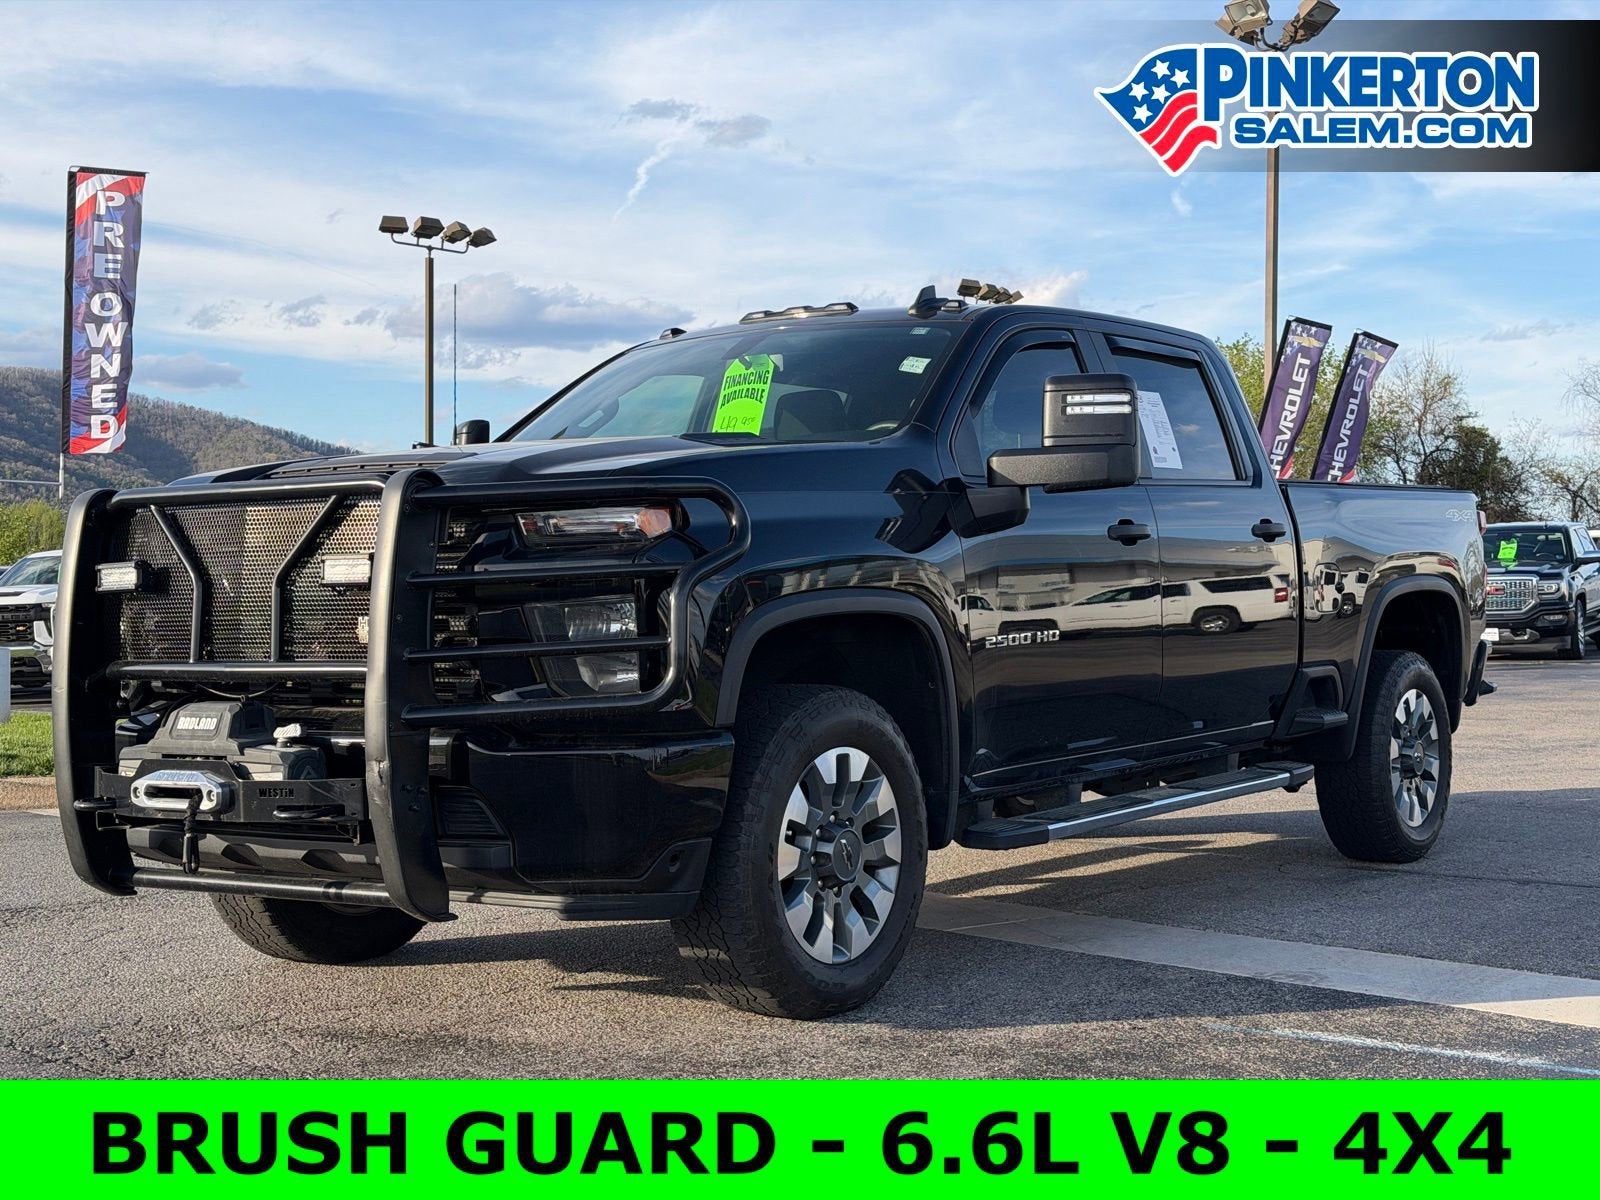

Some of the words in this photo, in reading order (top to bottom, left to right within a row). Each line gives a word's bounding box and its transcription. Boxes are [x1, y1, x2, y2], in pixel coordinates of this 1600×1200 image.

[93, 190, 126, 279] PRE
[85, 291, 128, 439] OWNED
[723, 369, 770, 391] FINANCING
[720, 387, 766, 409] AVAILABLE
[1270, 353, 1311, 479] HEVROLET
[985, 632, 1031, 649] 2500
[1036, 629, 1060, 643] HD
[176, 716, 218, 730] BADLAND
